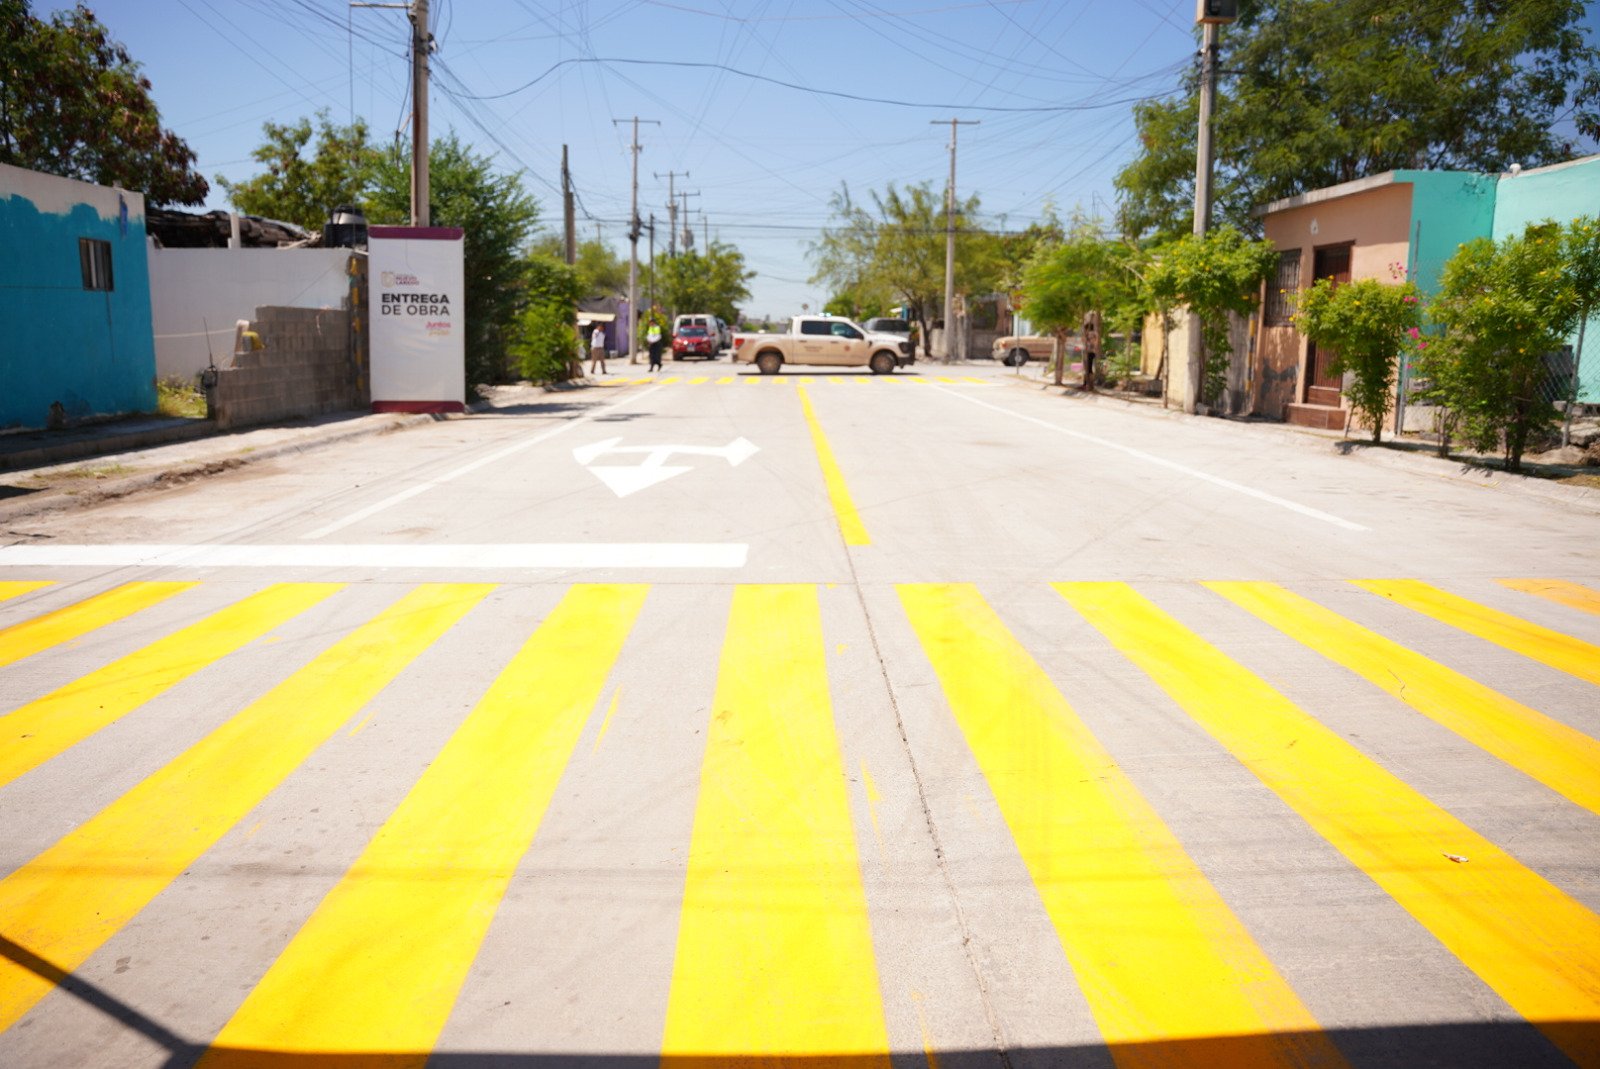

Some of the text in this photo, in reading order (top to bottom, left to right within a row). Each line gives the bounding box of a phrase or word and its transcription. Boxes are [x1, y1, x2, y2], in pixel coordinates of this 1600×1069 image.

[382, 293, 450, 304] ENTREGA
[382, 304, 450, 316] DE OBRA
